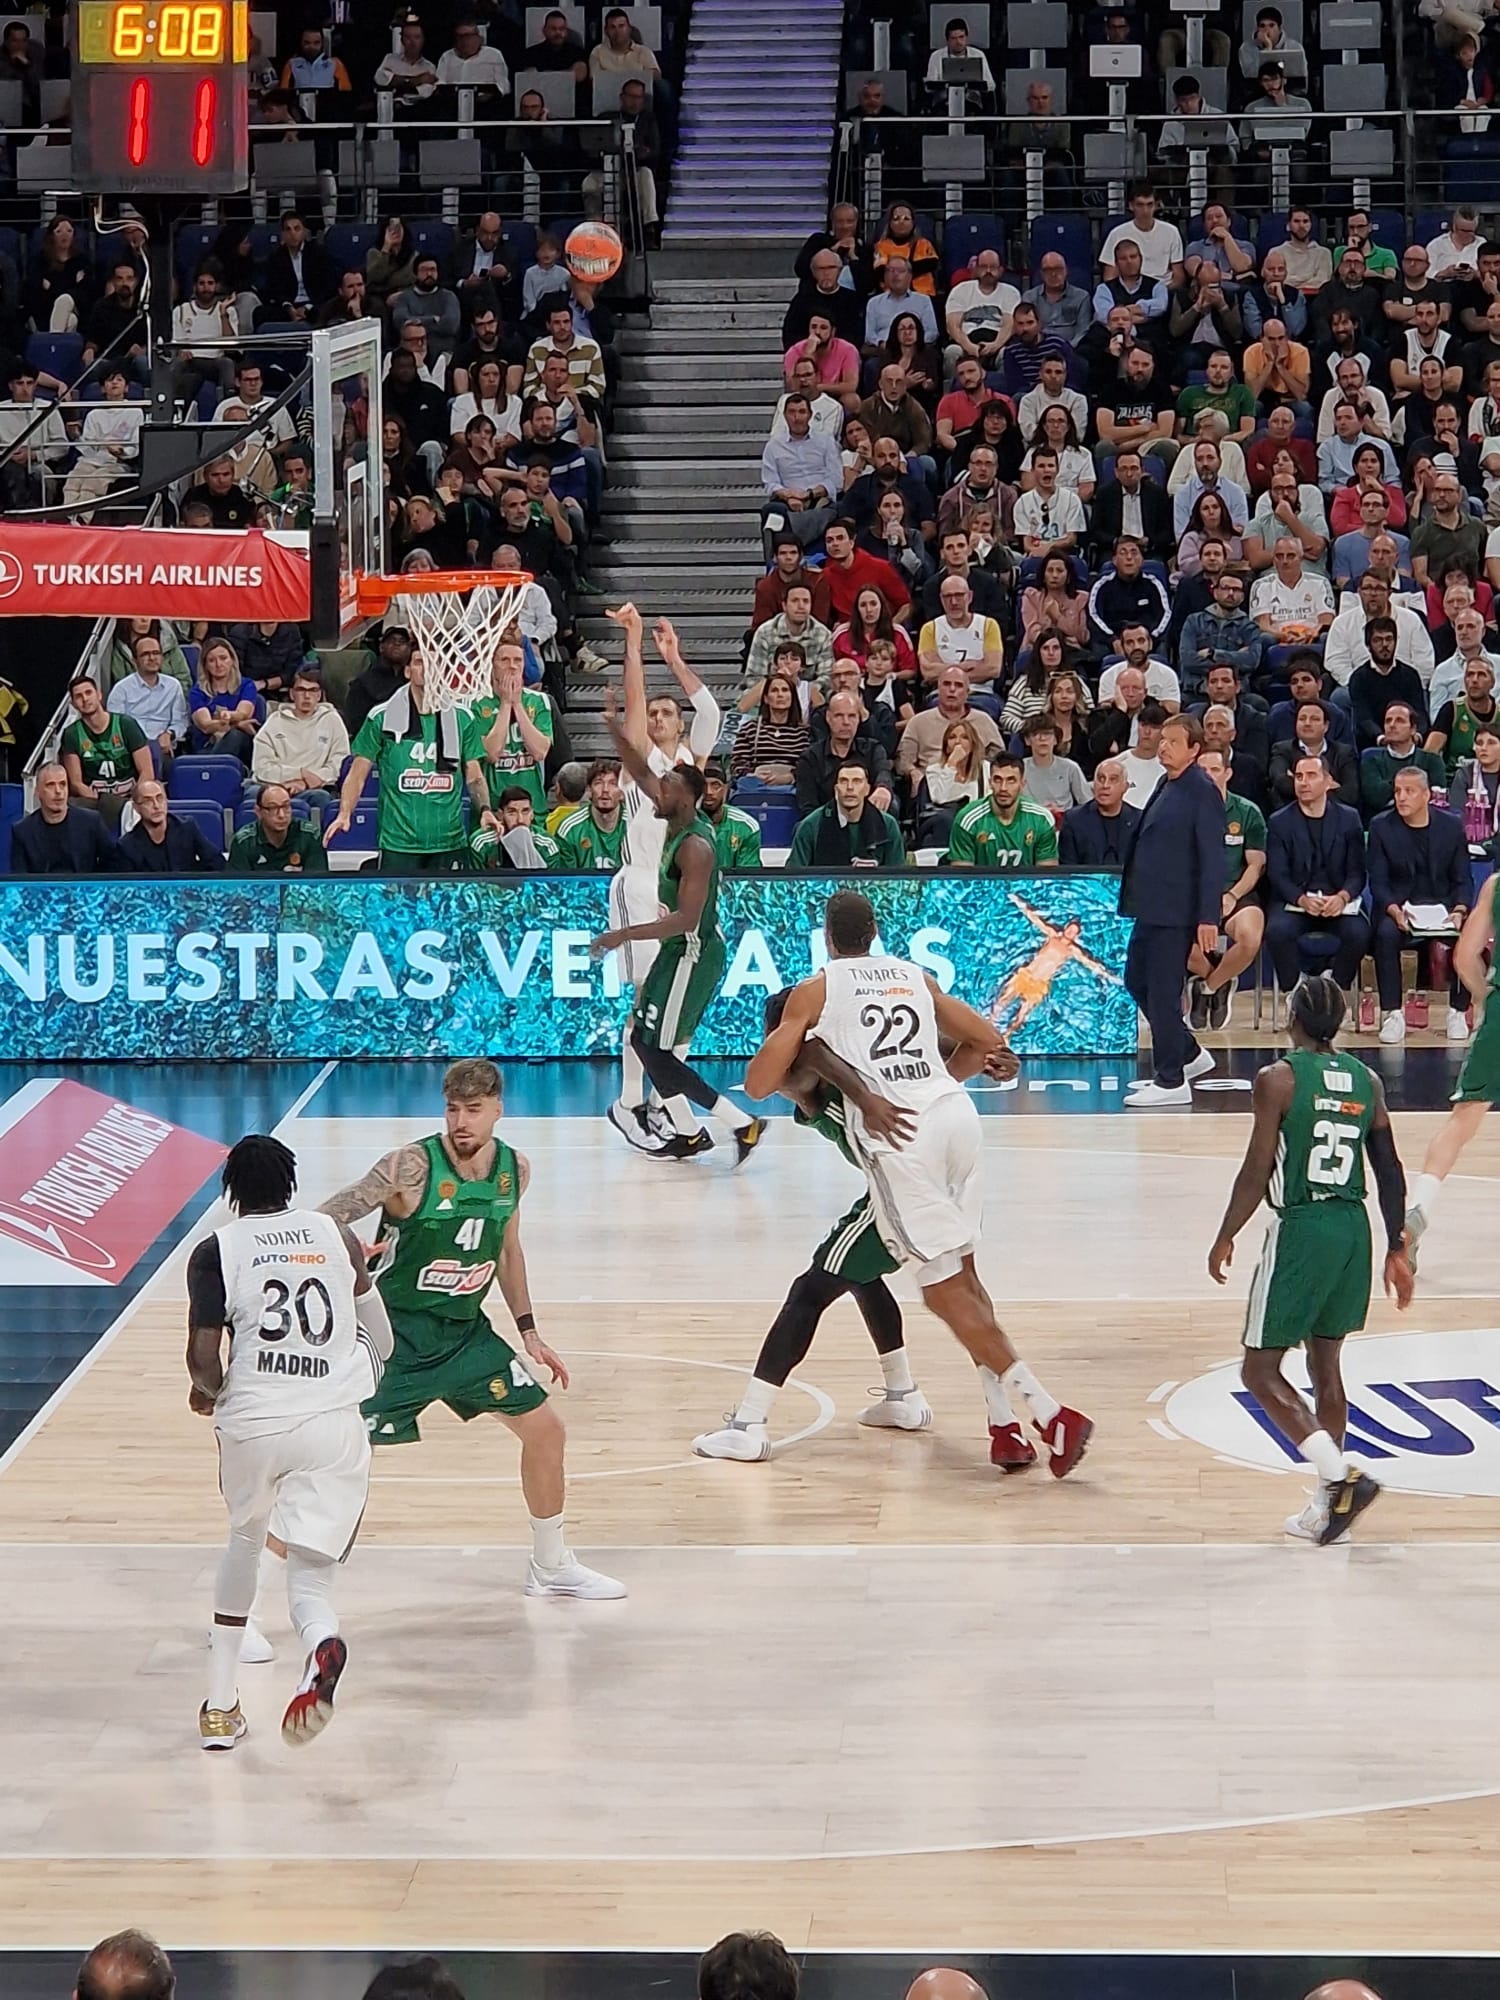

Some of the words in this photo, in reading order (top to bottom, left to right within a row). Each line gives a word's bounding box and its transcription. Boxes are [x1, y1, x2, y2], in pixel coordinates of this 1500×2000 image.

[114, 5, 223, 57] 6:08
[129, 79, 216, 166] 11
[33, 564, 143, 585] TURKISH
[150, 565, 263, 587] AIRLINES
[99, 761, 116, 778] 41
[410, 742, 438, 764] 44
[0, 931, 453, 1002] NUESTRAS
[854, 986, 915, 997] AUTOHERO
[860, 1003, 924, 1062] 22
[19, 1151, 129, 1226] TURKISH
[74, 1103, 175, 1176] AIRLINES
[1307, 1119, 1361, 1187] 25
[254, 1228, 315, 1247] NDIAYE
[454, 1217, 486, 1252] 41
[252, 1253, 327, 1269] AUTOHERO
[258, 1277, 335, 1348] 30
[256, 1350, 331, 1380] MADRID
